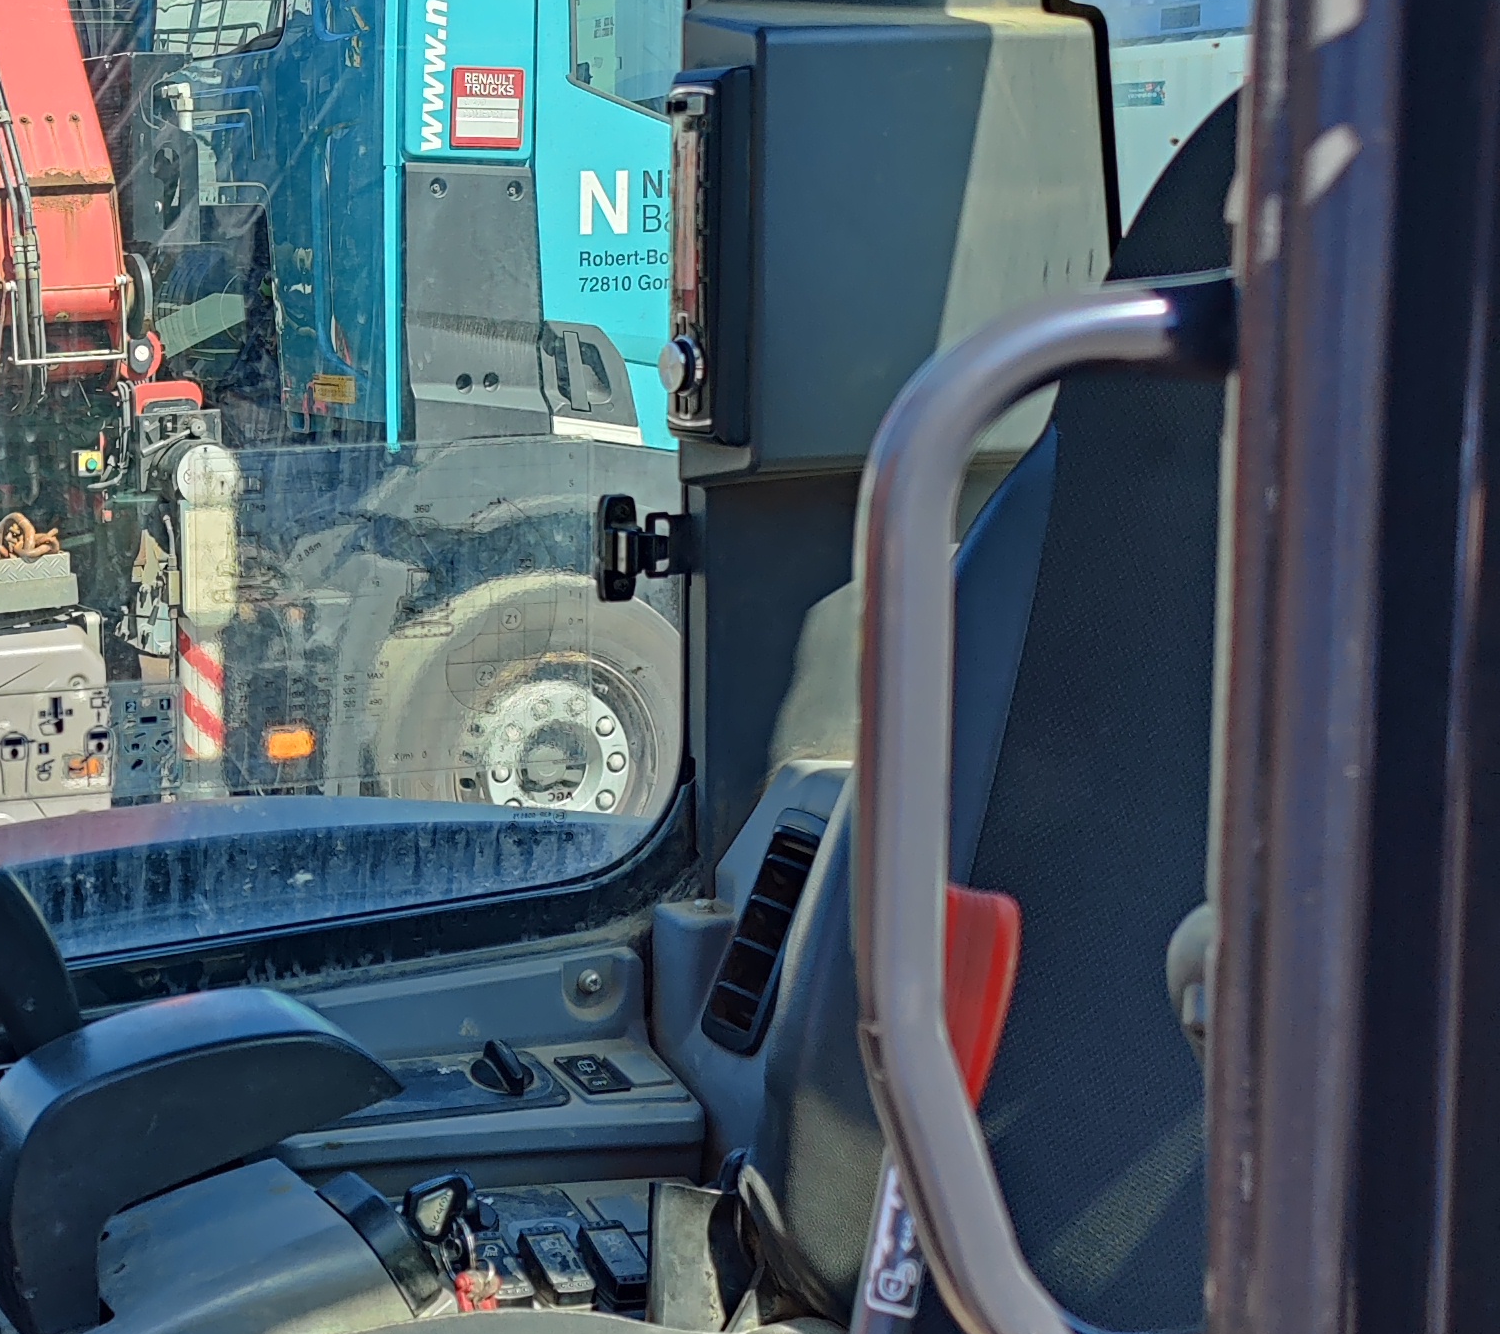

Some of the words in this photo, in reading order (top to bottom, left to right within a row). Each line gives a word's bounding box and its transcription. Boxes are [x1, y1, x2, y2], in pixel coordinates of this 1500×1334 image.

[464, 72, 515, 85] RENAULT
[464, 83, 515, 96] TRUCKS
[579, 170, 629, 235] N
[579, 249, 670, 268] Robert-Bo
[579, 275, 632, 293] 72810
[413, 503, 433, 514] 360°
[505, 614, 518, 625] Z1
[366, 671, 385, 680] MAX
[479, 670, 493, 681] Z3
